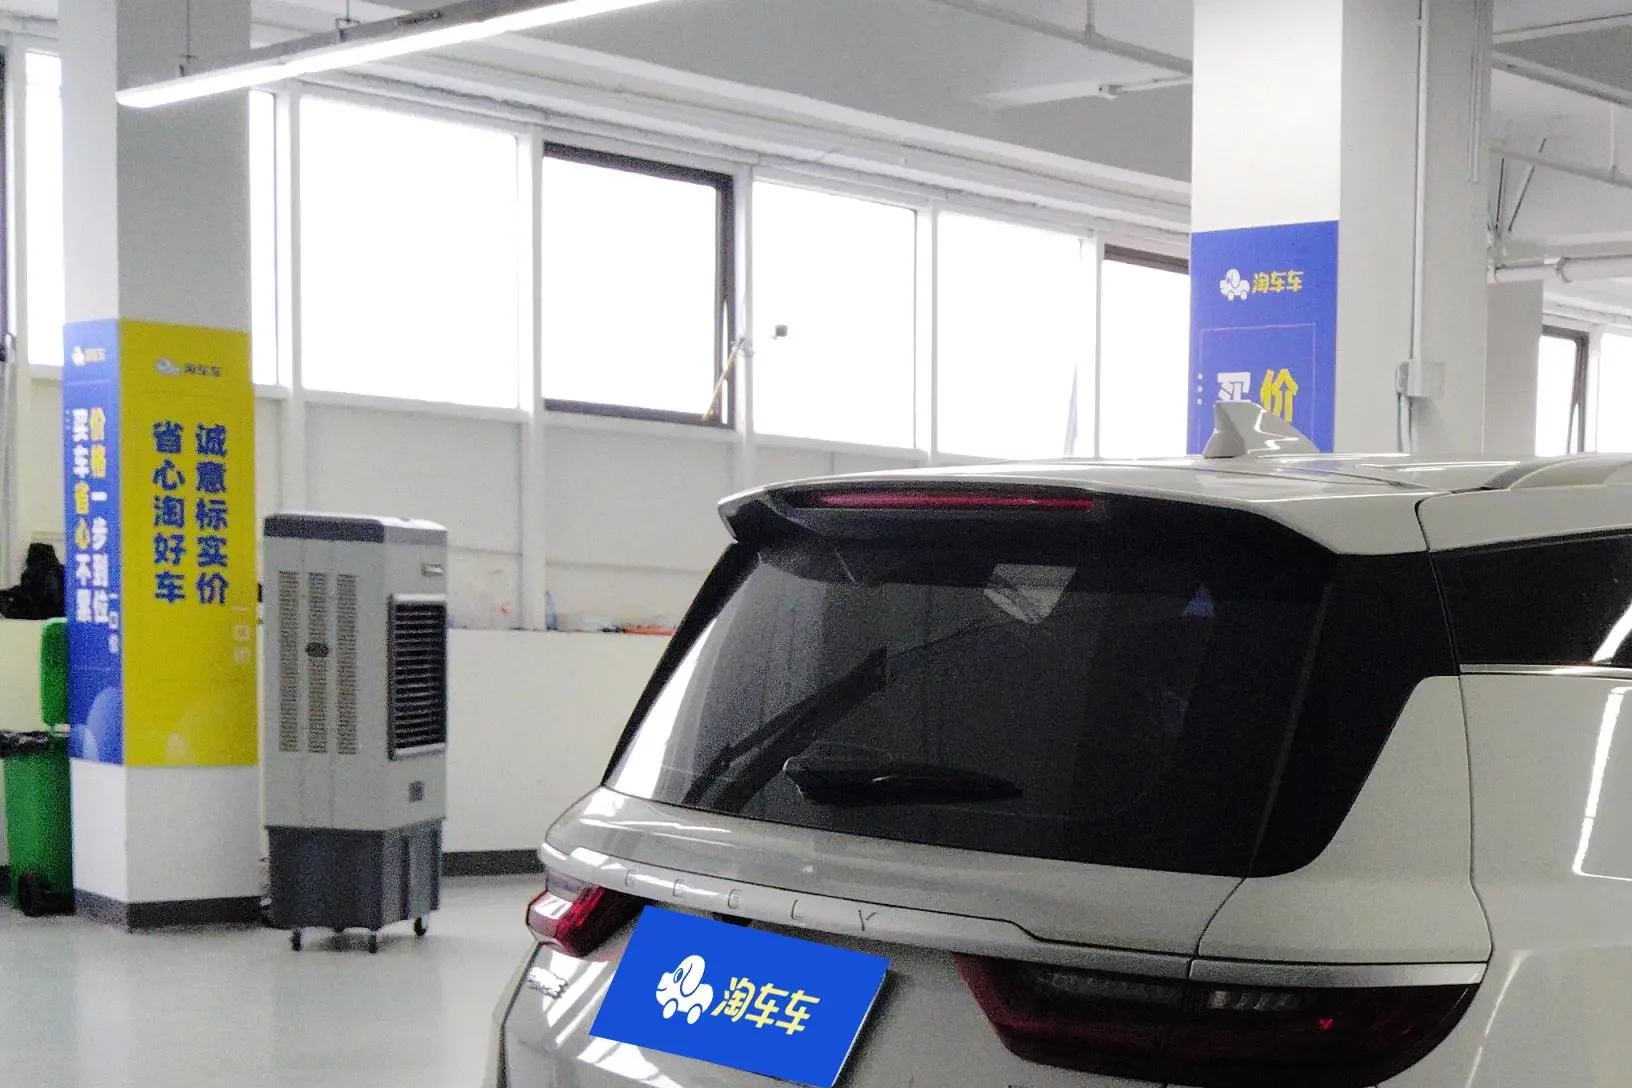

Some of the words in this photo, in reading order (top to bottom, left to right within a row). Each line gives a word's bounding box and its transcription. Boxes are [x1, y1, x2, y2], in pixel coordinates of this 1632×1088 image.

[1251, 269, 1304, 294] 淘车车
[1260, 368, 1299, 423] 价
[152, 419, 187, 604] 省心淘好车
[195, 422, 229, 606] 诚意标实价
